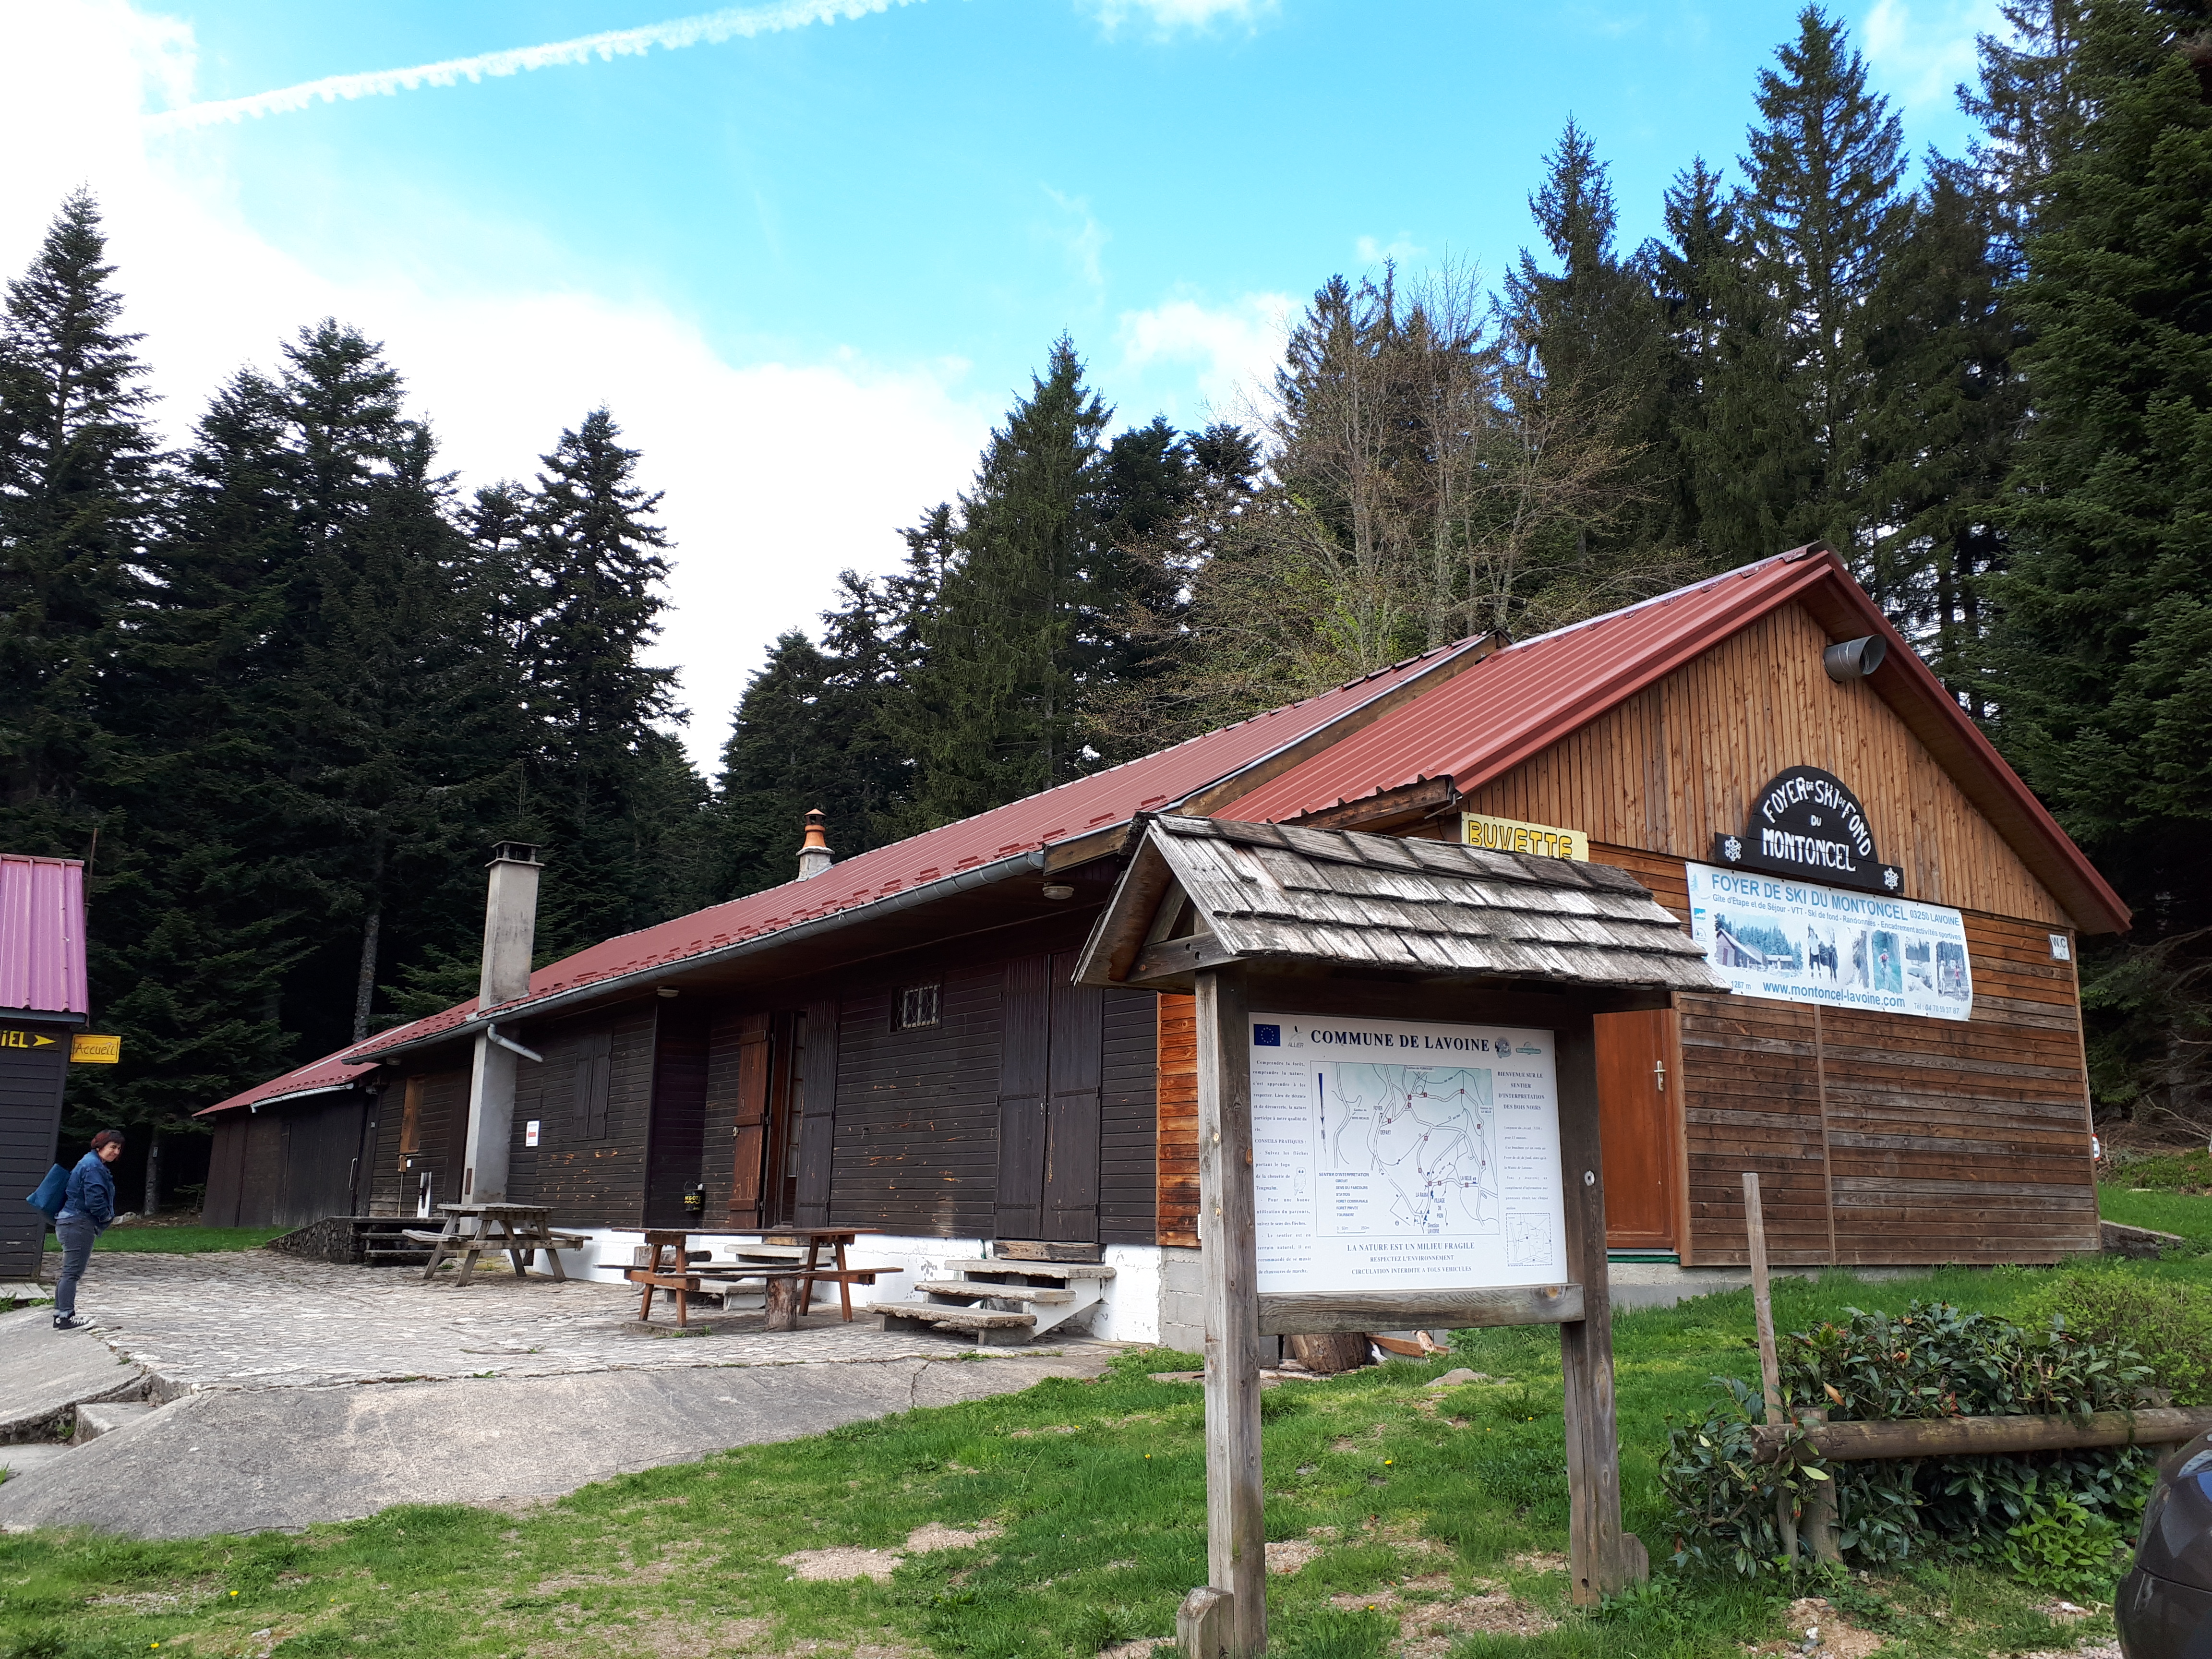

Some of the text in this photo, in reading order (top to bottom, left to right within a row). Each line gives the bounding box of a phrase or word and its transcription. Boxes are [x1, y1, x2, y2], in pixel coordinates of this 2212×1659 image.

[1763, 777, 1871, 856] FOYER DE SKI DE FOND
[1811, 815, 1822, 827] DU
[1468, 820, 1572, 859] BUVETTE
[1763, 827, 1856, 872] MONTONCEL
[1712, 874, 1960, 926] FOYER DE SKI DU MONTONCEL 03250 LAVOINE
[1727, 896, 1749, 908] d'Etape
[1758, 902, 1766, 910] de
[1767, 902, 1786, 913] Séjour
[1791, 907, 1803, 915] VTT
[1808, 909, 1817, 917] Ski
[1827, 912, 1839, 921] fond
[1843, 915, 1876, 927] Randonnées
[1881, 921, 1915, 933] Encadrement
[1916, 927, 1937, 936] activités
[1939, 930, 1961, 940] sportives
[2051, 937, 2066, 949] W.C
[1731, 980, 1744, 989] 1287
[1763, 982, 1905, 1008] www.montoncel-lavoine.com
[75, 1043, 115, 1055] Accueil
[1311, 1030, 1490, 1052] COMMUNE DE LAVOINE
